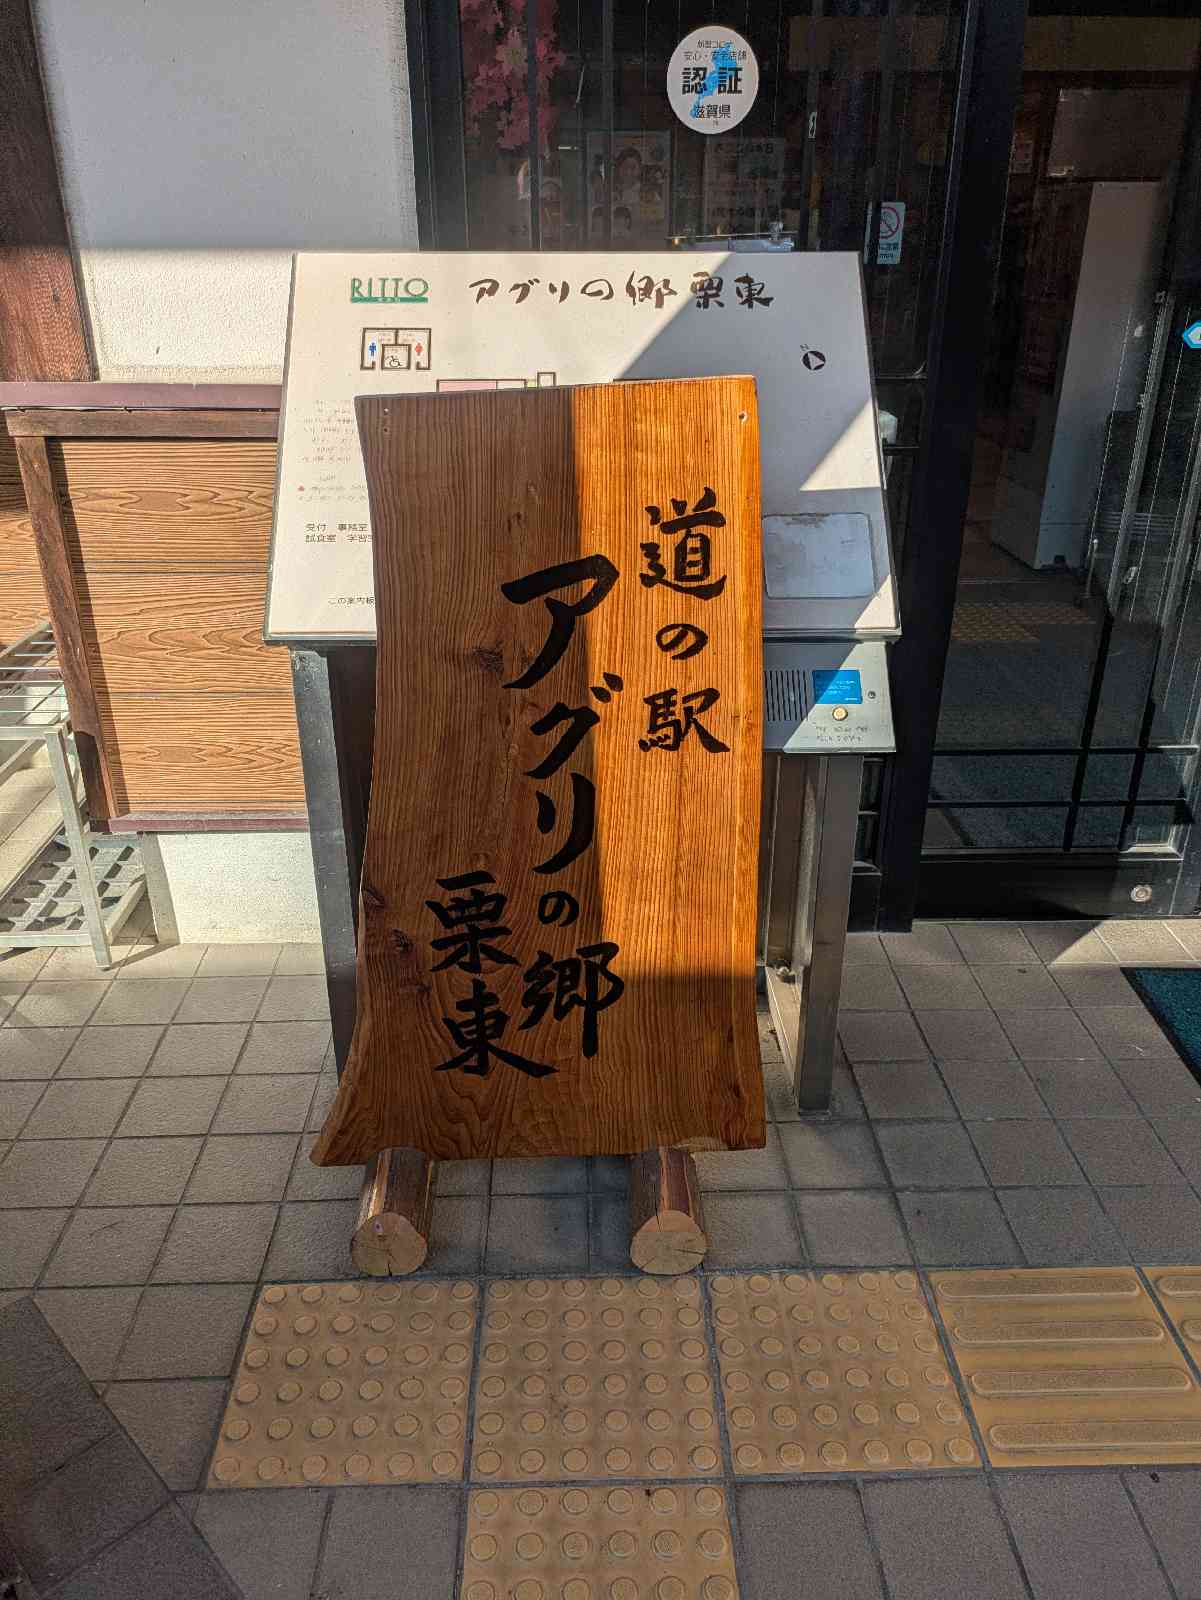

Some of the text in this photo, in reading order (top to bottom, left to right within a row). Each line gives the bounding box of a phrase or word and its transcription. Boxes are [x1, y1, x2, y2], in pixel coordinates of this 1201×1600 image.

[682, 67, 743, 95] 認証
[696, 104, 731, 118] 滋賀県
[351, 277, 429, 297] RITTO
[638, 486, 731, 754] 道の駅
[500, 554, 625, 1059] アグリの郷
[425, 871, 560, 1078] 栗東
